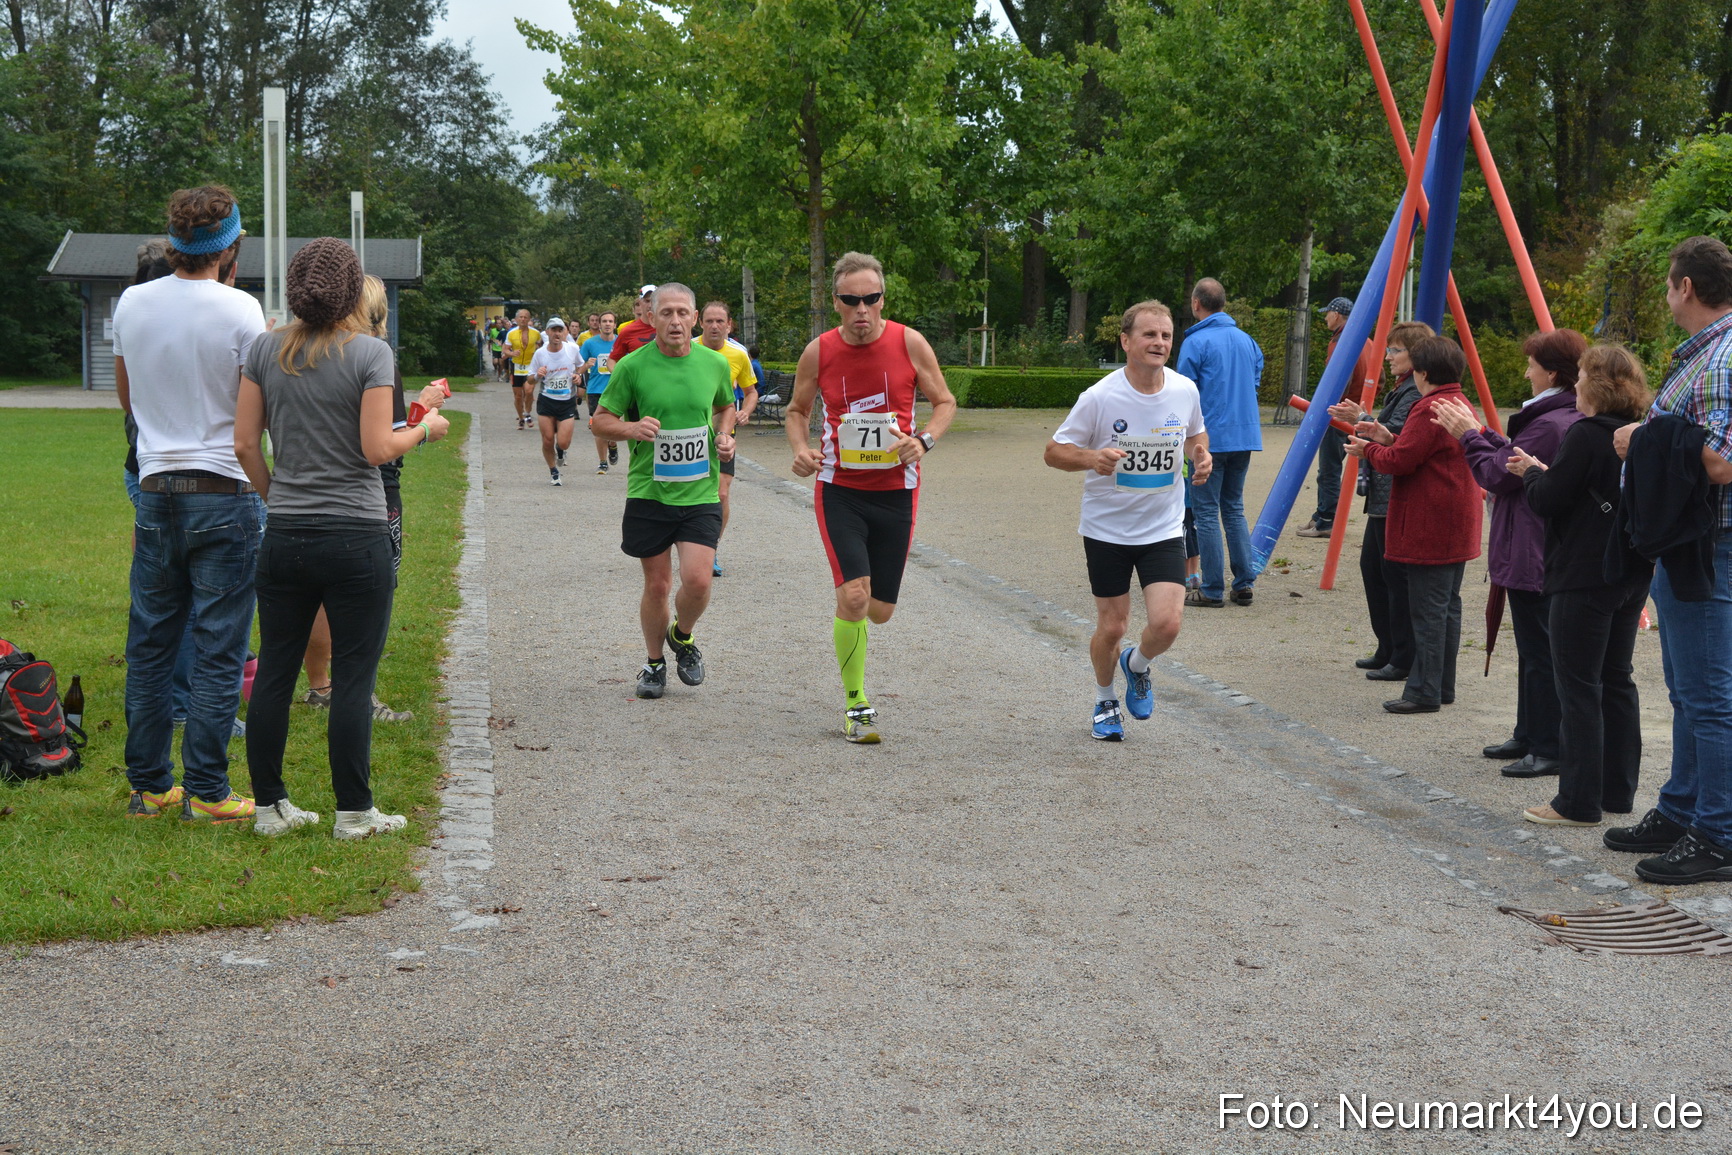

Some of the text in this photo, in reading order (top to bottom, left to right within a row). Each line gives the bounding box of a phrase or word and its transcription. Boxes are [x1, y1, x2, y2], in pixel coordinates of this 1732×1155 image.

[860, 399, 876, 408] DEHN
[857, 427, 881, 448] 71
[1118, 440, 1141, 448] PARTL
[660, 439, 704, 462] 3302
[860, 453, 882, 462] Peter
[1123, 449, 1175, 472] 3345
[157, 479, 198, 492] PMA
